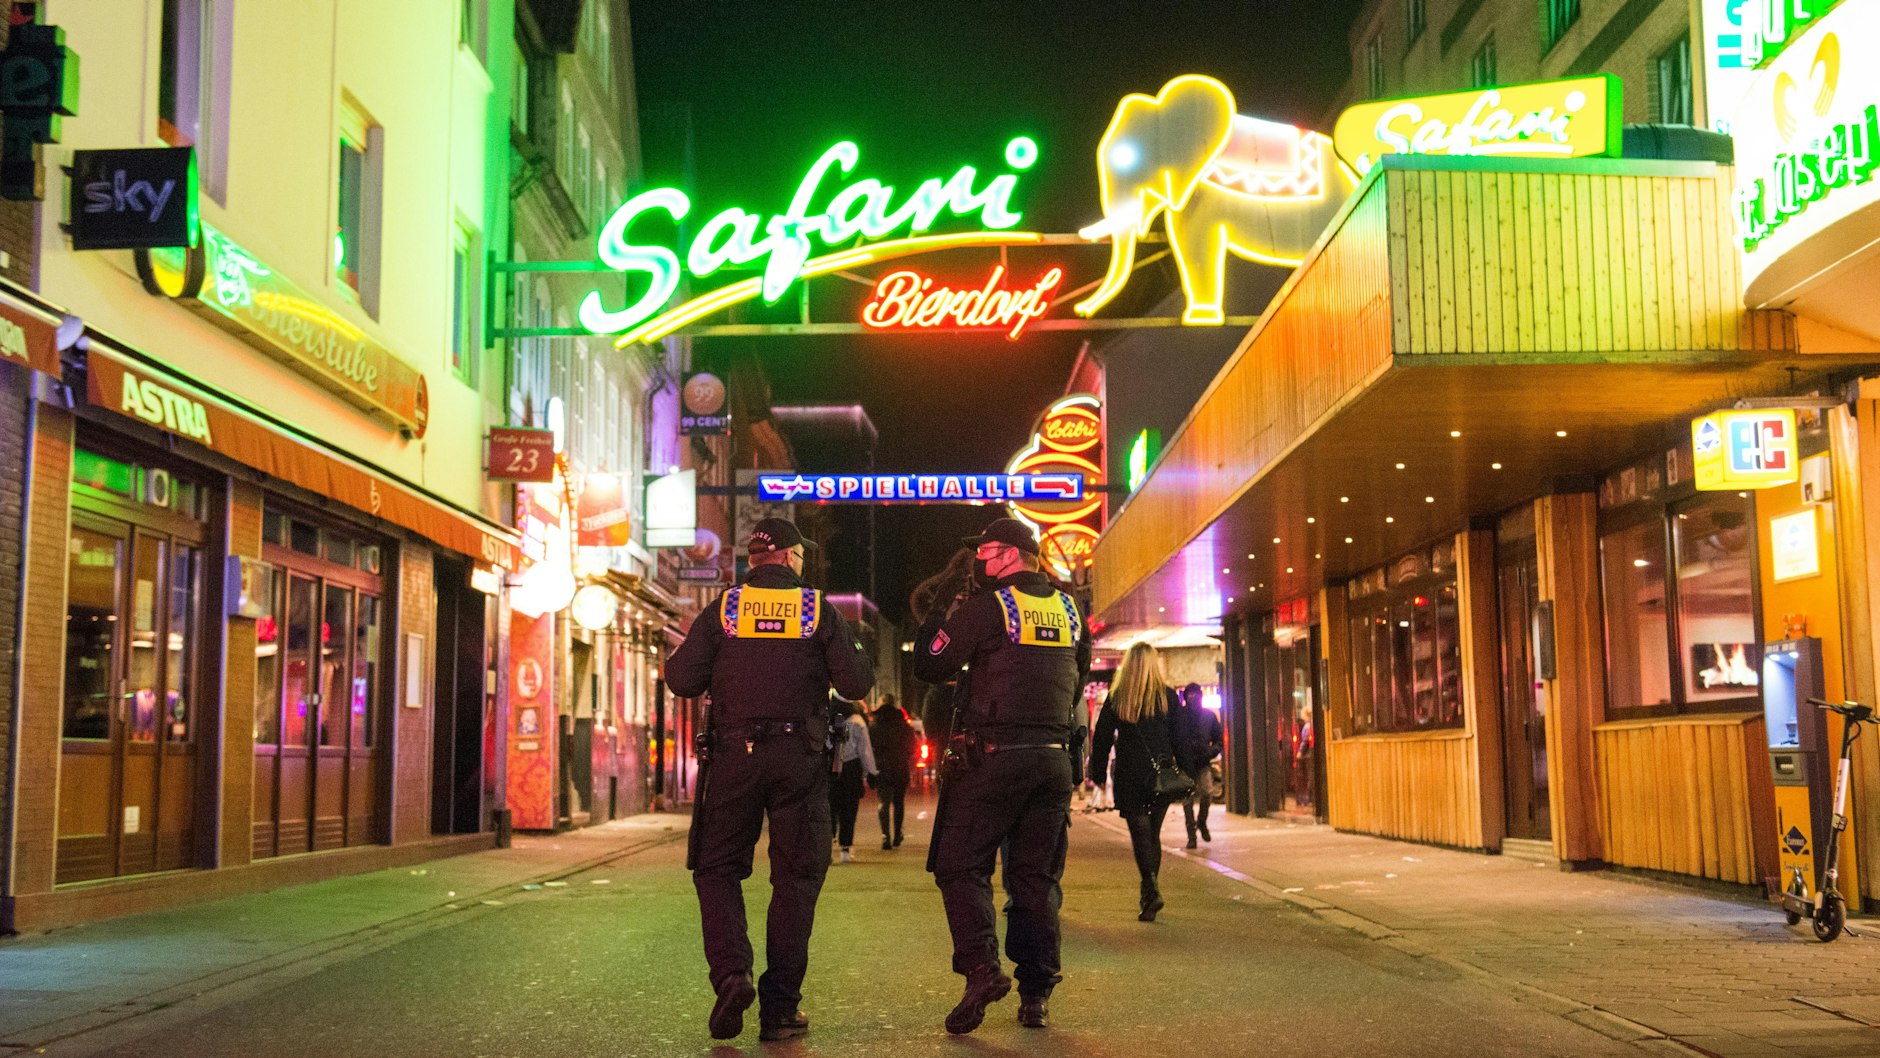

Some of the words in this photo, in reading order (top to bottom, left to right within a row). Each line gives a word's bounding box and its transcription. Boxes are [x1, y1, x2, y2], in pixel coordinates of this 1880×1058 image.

[1356, 90, 1586, 174] Safari
[84, 169, 176, 222] sky
[578, 139, 1038, 335] Safari
[863, 264, 1062, 338] Bierdorf
[121, 372, 213, 444] ASTRA
[681, 416, 695, 428] 99
[697, 416, 727, 428] CENT
[1046, 419, 1097, 439] Colibri
[506, 448, 539, 473] 23
[816, 476, 1026, 499] SPIELHALLE
[482, 533, 513, 570] ASTRA
[743, 602, 797, 618] POLIZEI
[1023, 610, 1067, 629] POLIZEI
